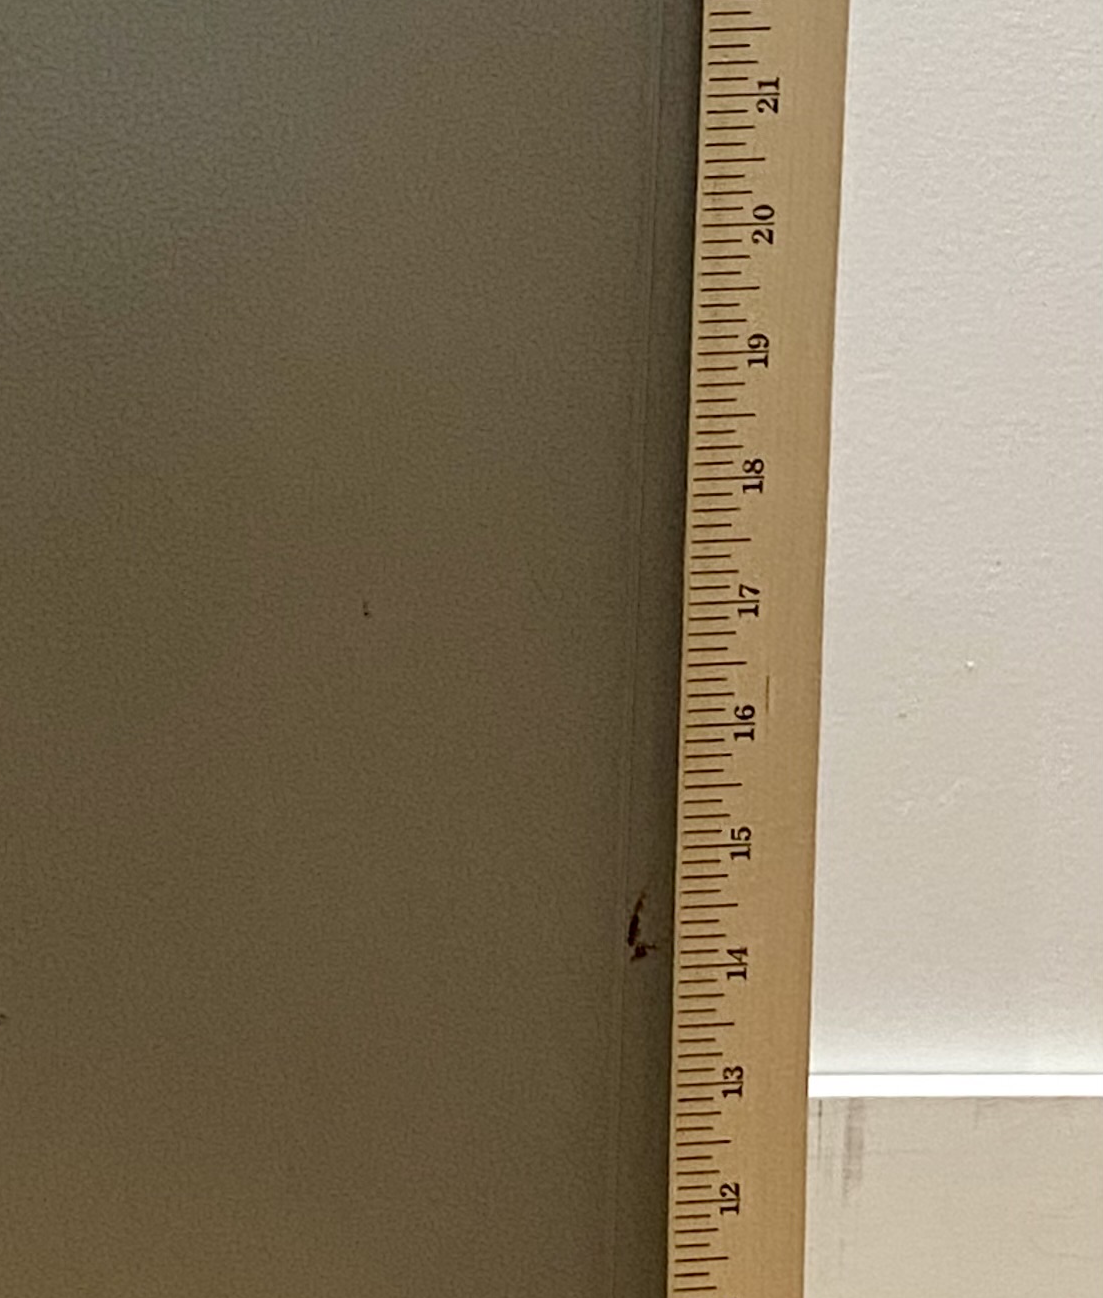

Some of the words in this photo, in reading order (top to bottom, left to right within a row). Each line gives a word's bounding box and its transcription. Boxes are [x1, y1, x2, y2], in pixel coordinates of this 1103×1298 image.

[756, 77, 780, 114] 21
[751, 204, 776, 245] 20
[746, 333, 770, 369] 19
[742, 458, 766, 495] 18
[736, 584, 760, 618] 17
[733, 704, 756, 742] 16
[729, 826, 752, 861] 15
[726, 947, 749, 981] 14
[722, 1066, 744, 1099] 13
[719, 1182, 741, 1216] 12
